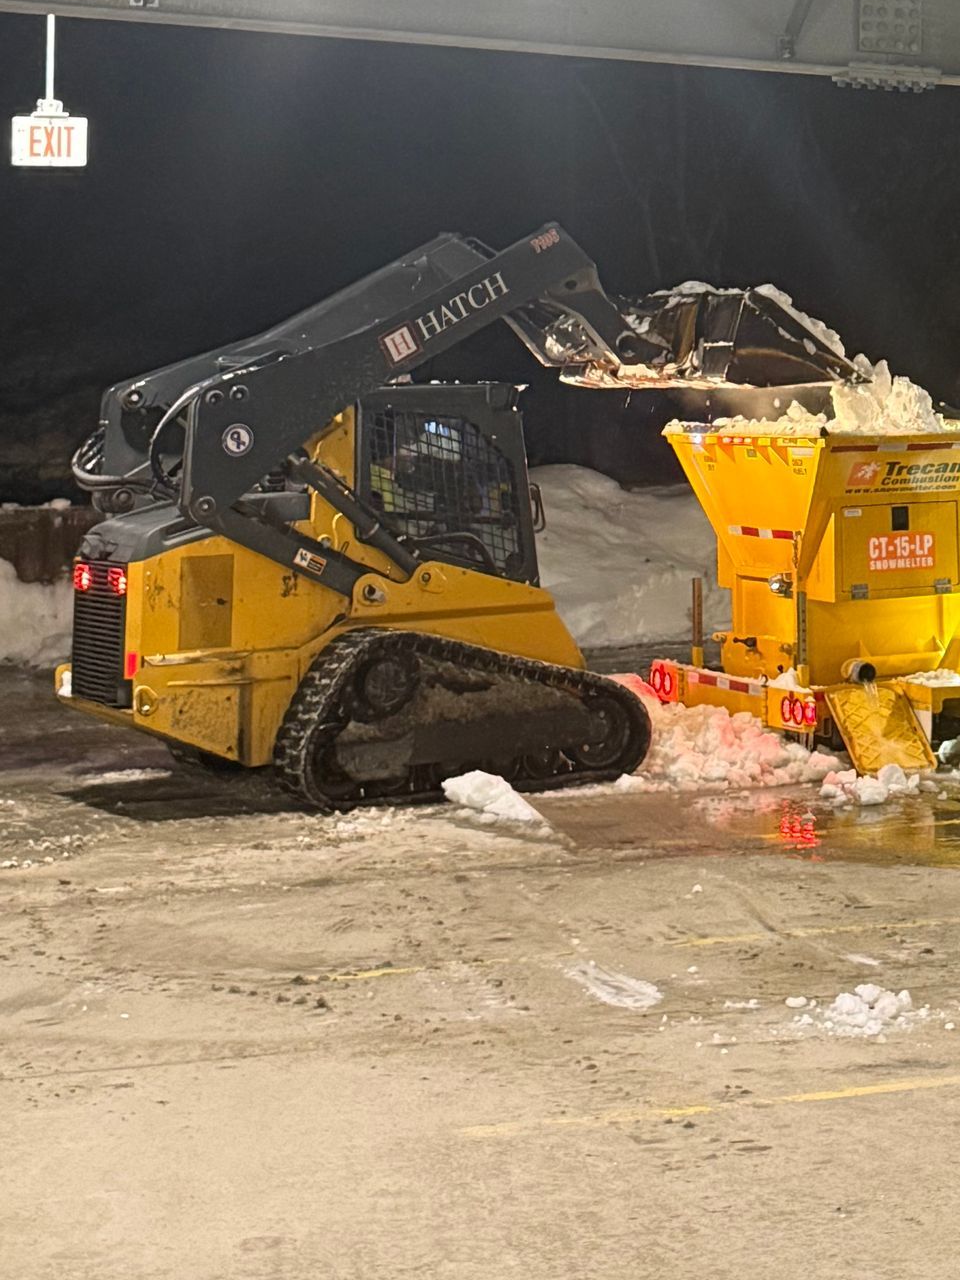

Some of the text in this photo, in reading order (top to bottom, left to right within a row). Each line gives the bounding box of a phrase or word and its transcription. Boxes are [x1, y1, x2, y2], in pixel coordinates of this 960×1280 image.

[29, 126, 75, 157] EXIT
[415, 272, 510, 341] HATCH
[881, 475, 960, 486] Combustion
[869, 534, 934, 559] CT-15-LP
[869, 557, 934, 570] SNOWMELTER
